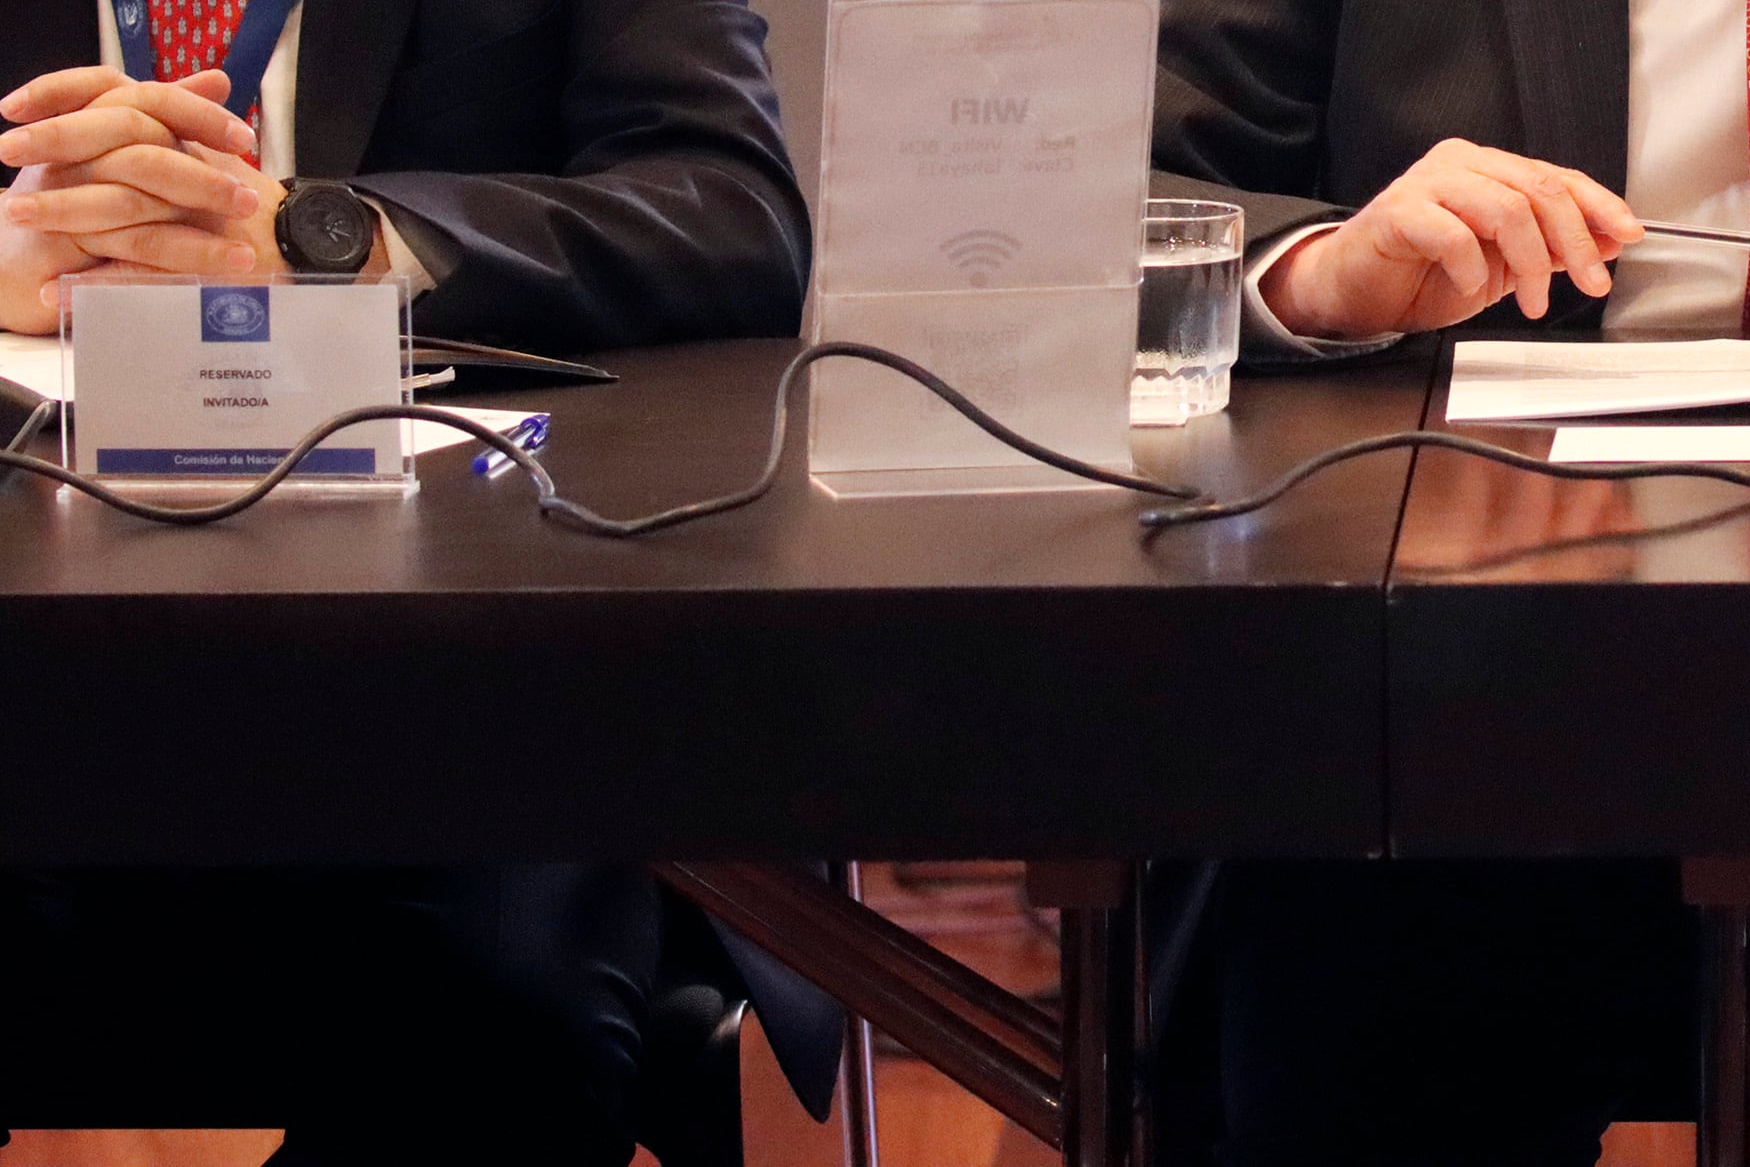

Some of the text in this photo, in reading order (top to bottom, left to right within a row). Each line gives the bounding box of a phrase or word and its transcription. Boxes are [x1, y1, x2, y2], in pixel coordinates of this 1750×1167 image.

[199, 369, 272, 380] RESERVADO
[203, 397, 269, 408] INVITADO/A
[174, 454, 227, 466] Comisión
[229, 454, 244, 465] de
